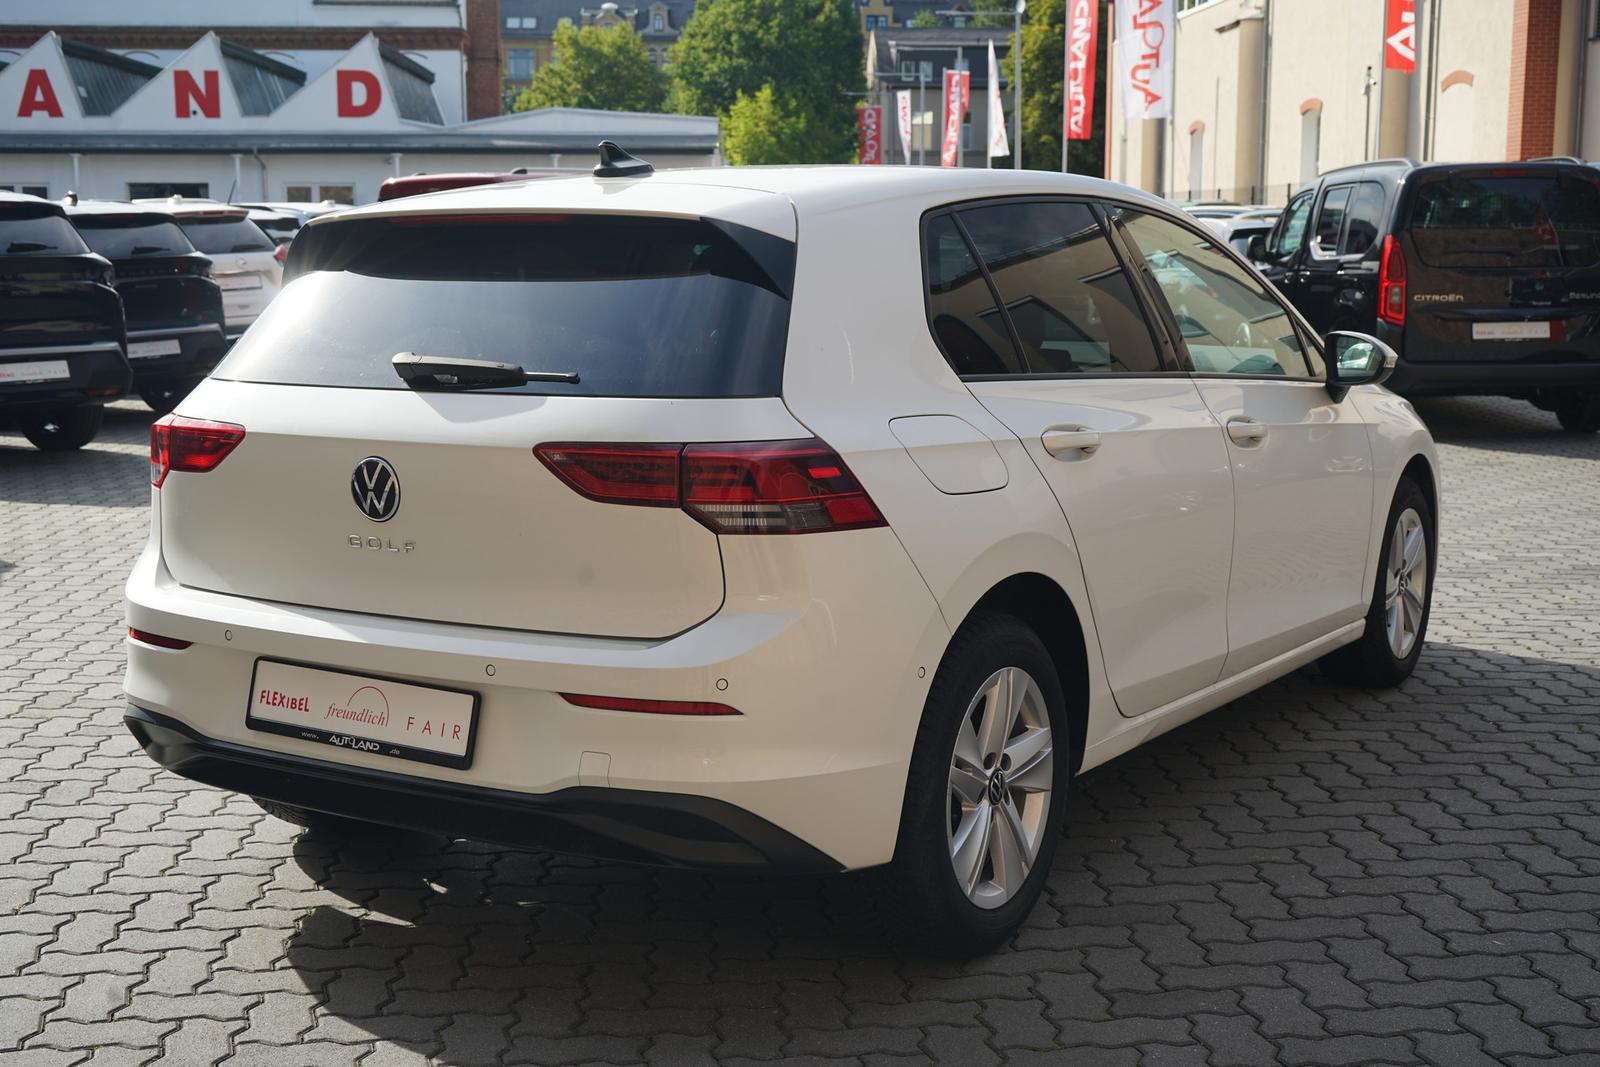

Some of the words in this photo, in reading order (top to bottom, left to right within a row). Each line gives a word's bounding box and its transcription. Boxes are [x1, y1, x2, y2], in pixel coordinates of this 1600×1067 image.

[348, 534, 416, 553] GOLF
[259, 690, 310, 713] FLEXIBEL
[324, 703, 386, 727] freundlich
[406, 716, 461, 740] FAIR
[329, 735, 380, 751] AUTOLAND
